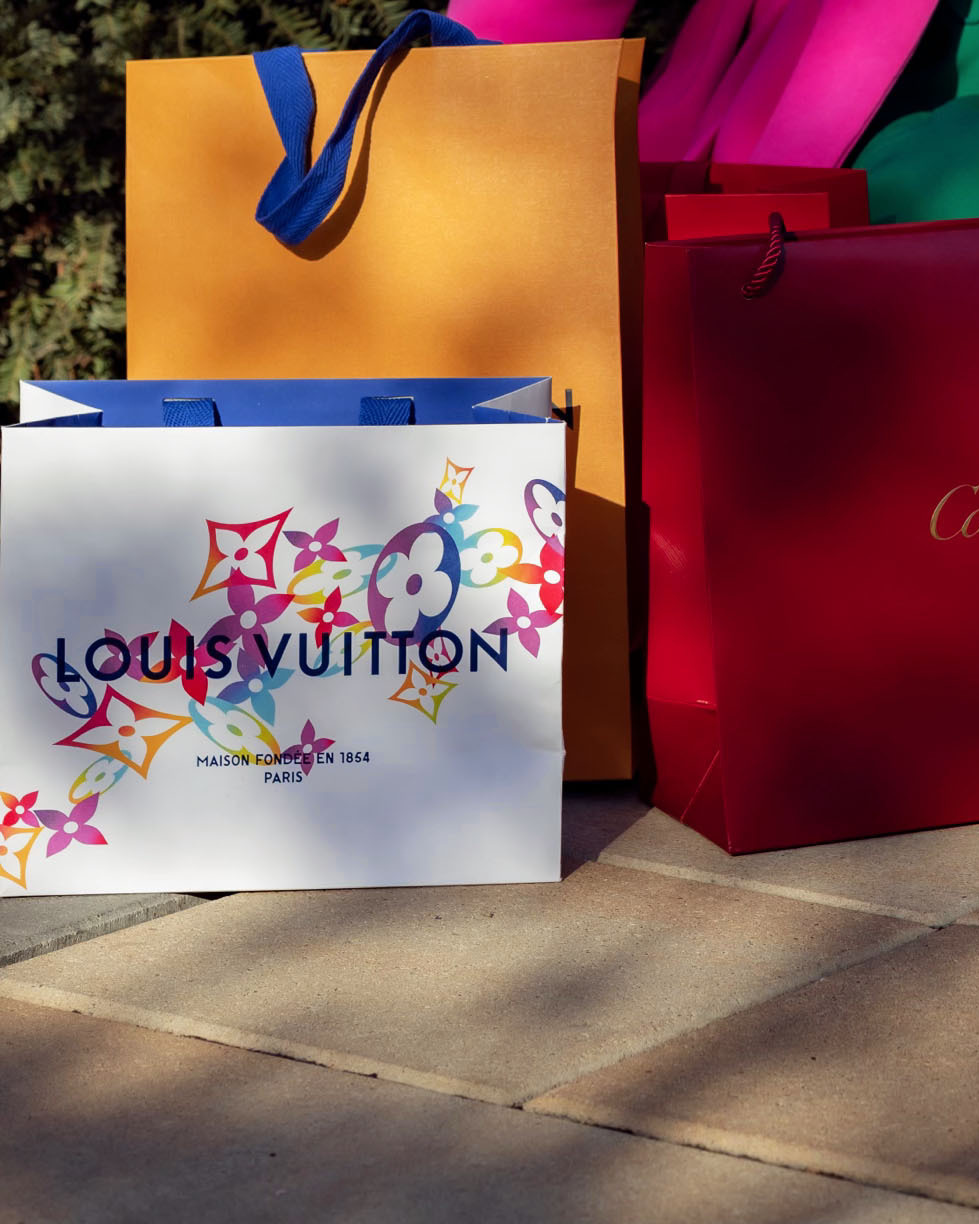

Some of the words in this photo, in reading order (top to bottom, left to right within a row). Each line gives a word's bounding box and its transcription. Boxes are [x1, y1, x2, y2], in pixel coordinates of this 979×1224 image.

[56, 634, 232, 683] LOUIS
[253, 627, 508, 680] VUITTON
[196, 754, 250, 767] MAISON
[255, 749, 312, 766] FONDÉE
[316, 752, 335, 764] EN
[340, 751, 371, 764] 1854
[264, 771, 304, 784] PARIS
